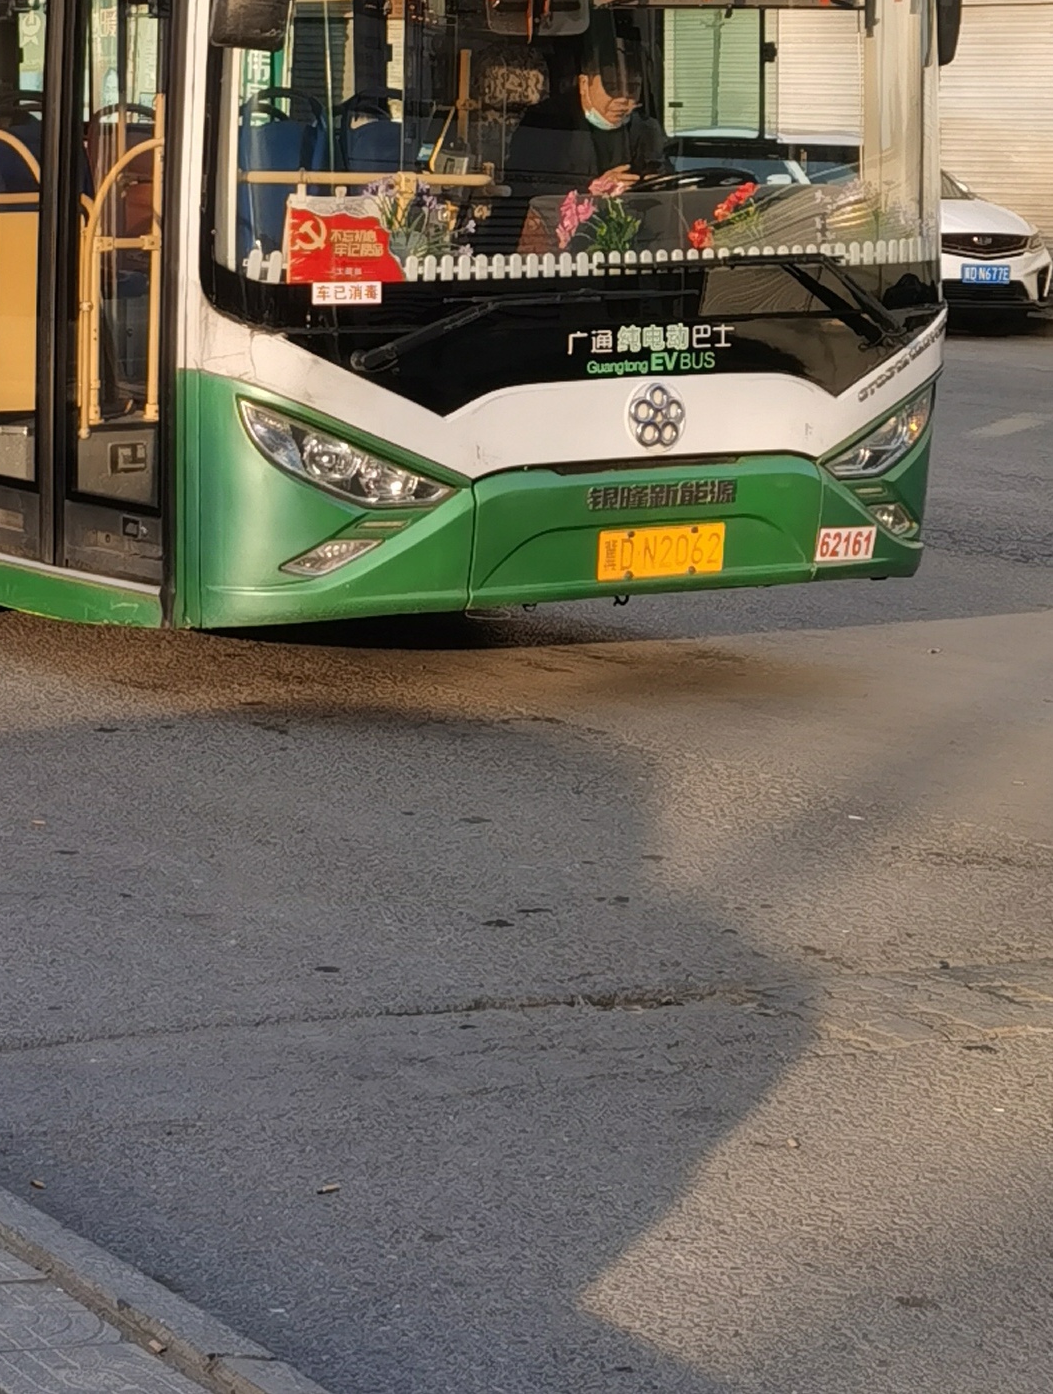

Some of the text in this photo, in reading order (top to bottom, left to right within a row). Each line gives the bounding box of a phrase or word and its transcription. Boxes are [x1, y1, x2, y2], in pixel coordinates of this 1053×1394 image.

[316, 285, 379, 301] 车已消毒
[567, 323, 735, 355] 广通纯电动巴士
[587, 360, 648, 375] Guangtong
[587, 478, 737, 511] 银隆新能源
[820, 530, 873, 558] 62161
